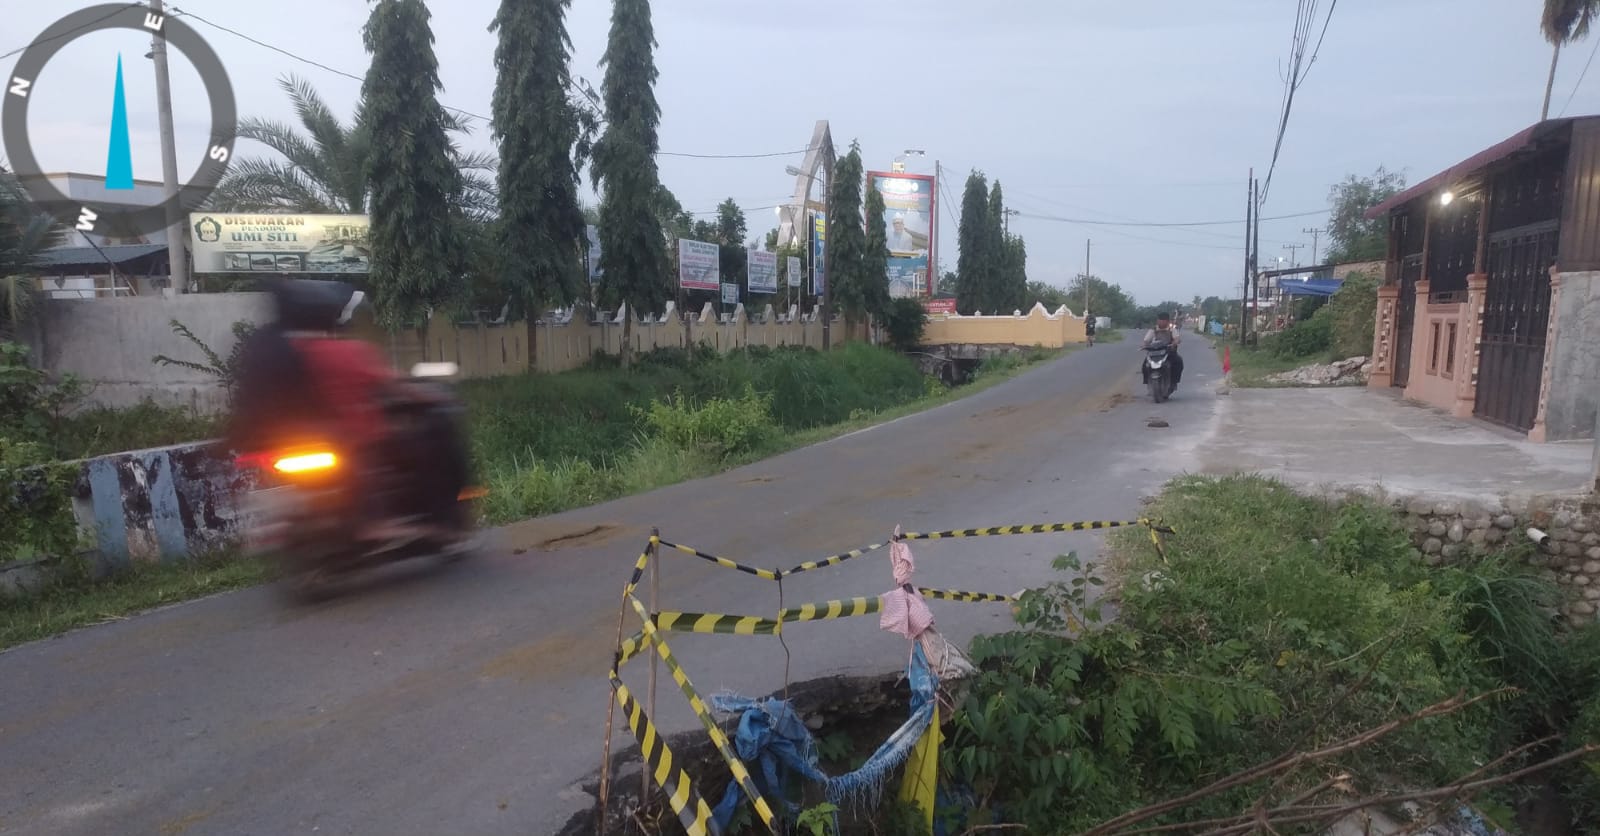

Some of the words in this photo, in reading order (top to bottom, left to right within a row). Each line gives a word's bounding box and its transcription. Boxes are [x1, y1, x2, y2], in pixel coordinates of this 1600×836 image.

[224, 217, 305, 226] DISEWAKAN
[231, 232, 263, 242] UMI
[267, 232, 298, 242] SITI
